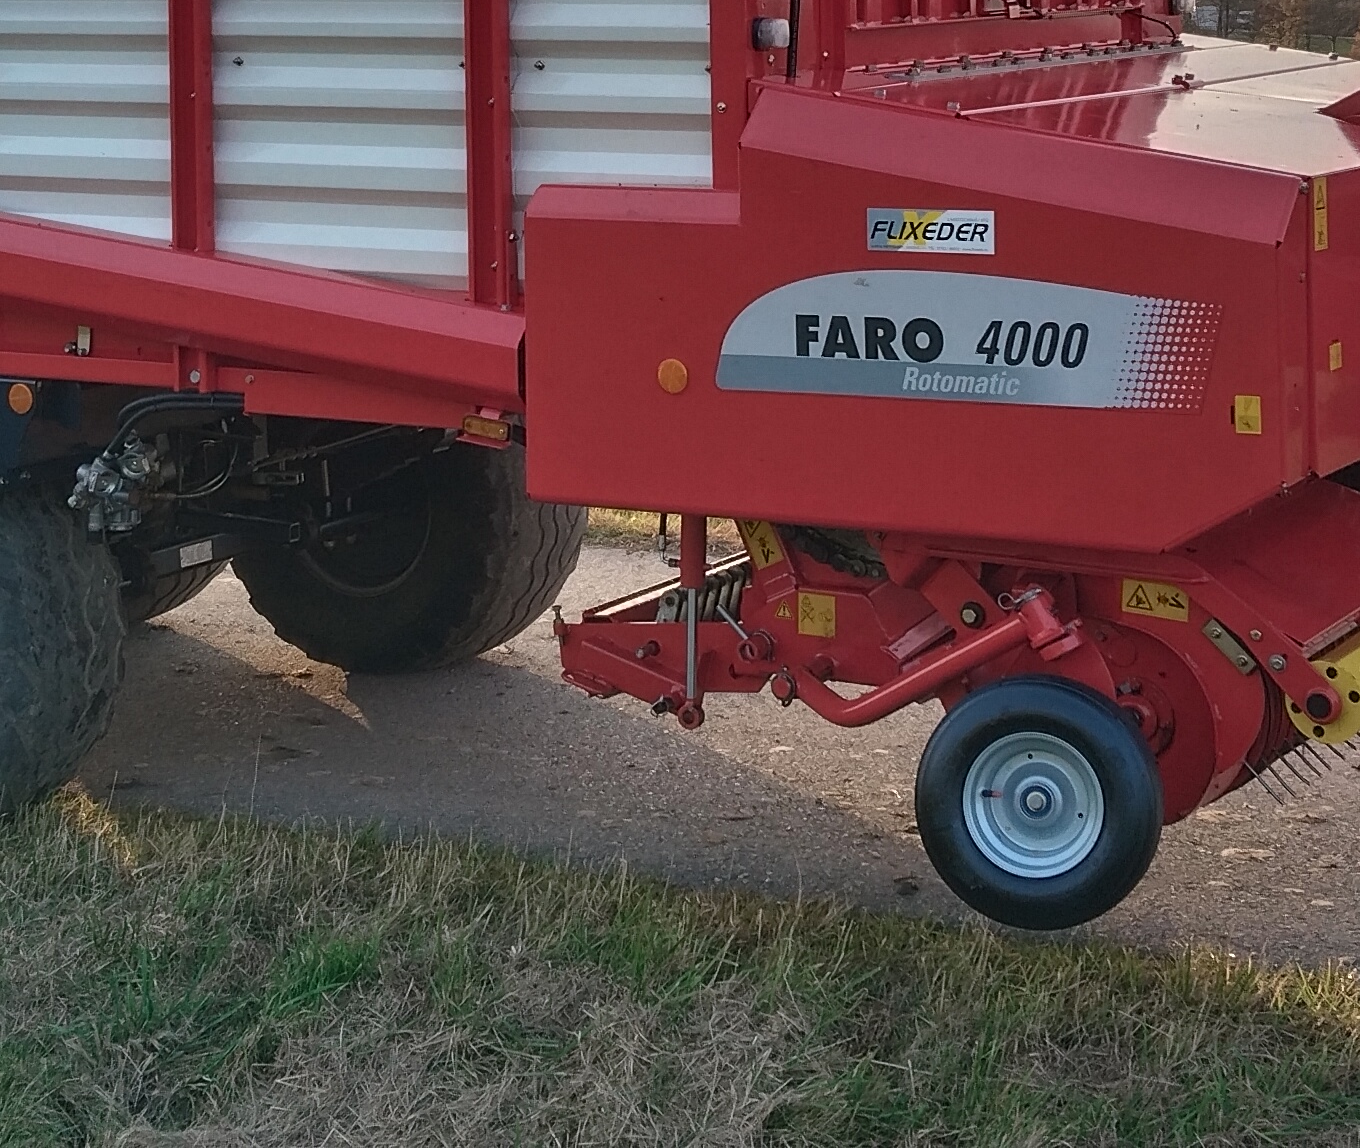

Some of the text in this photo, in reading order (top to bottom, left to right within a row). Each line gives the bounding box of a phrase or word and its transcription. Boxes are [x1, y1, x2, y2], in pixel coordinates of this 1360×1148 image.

[869, 220, 990, 243] FLIXEDER
[795, 314, 1090, 369] FARO 4000
[902, 366, 1021, 396] Rotomatic
